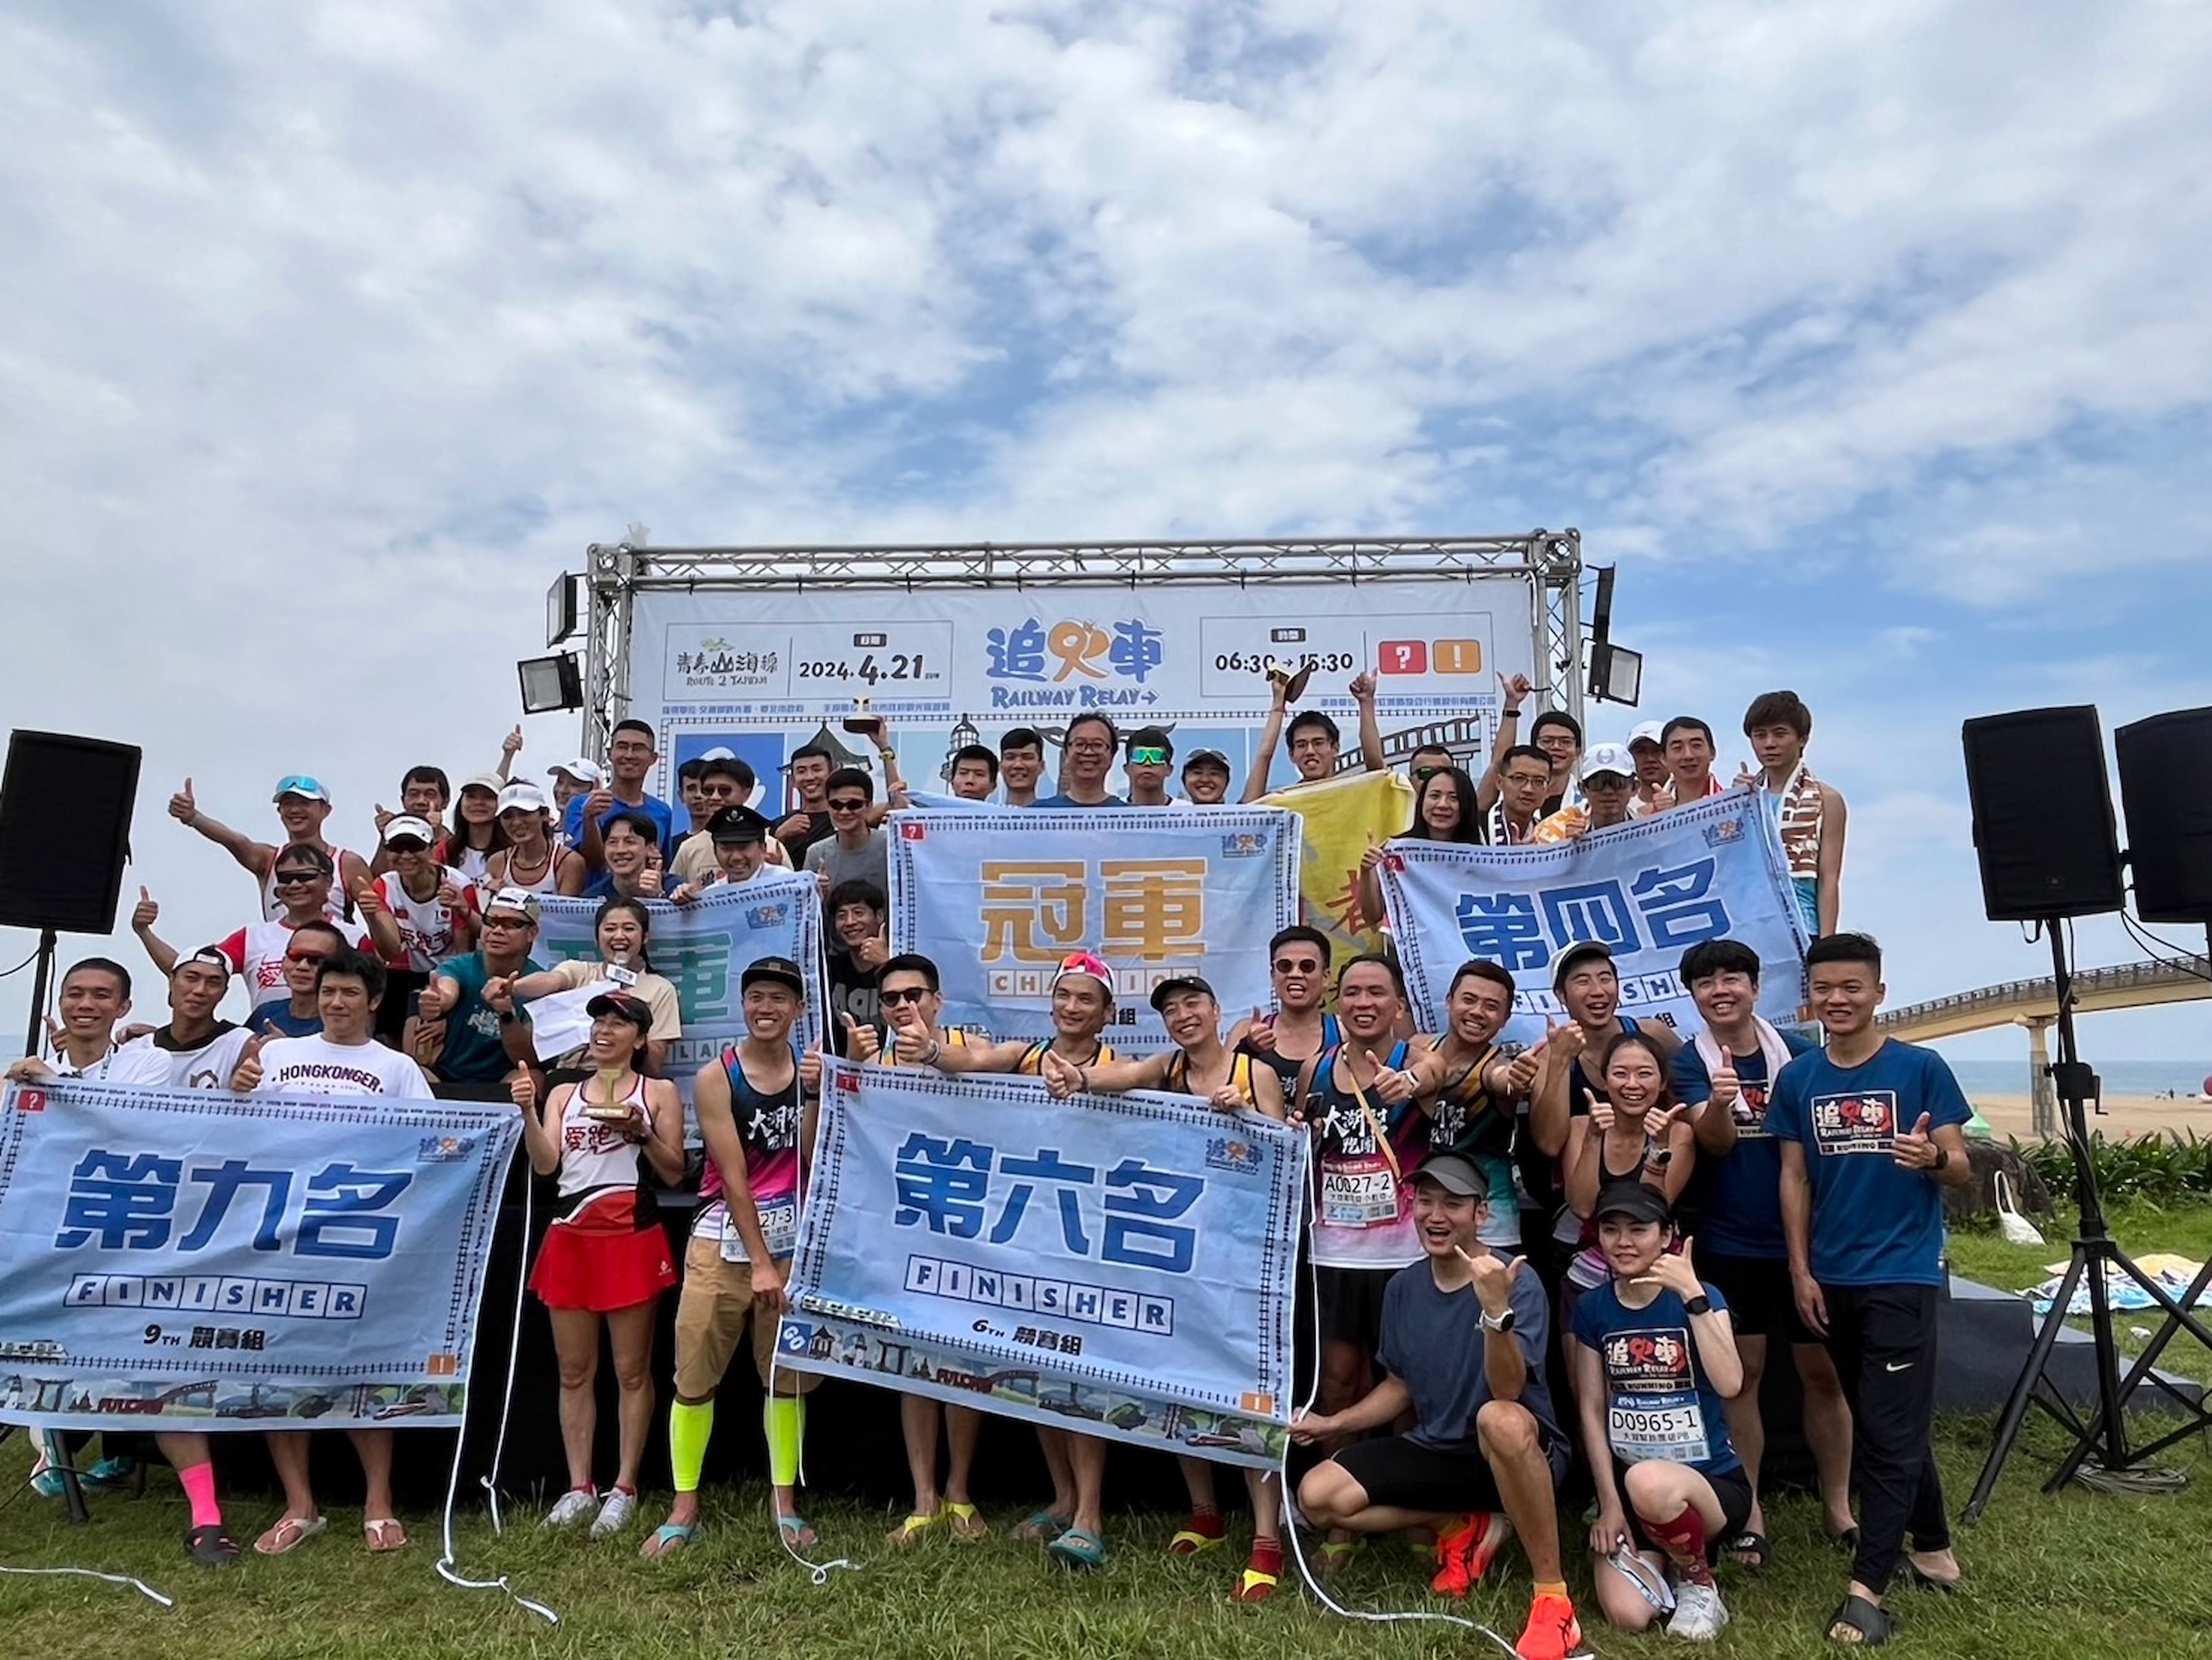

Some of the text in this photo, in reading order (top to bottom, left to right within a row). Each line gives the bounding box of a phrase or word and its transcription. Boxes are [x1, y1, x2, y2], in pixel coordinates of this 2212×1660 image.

[1395, 646, 1411, 669] ?
[991, 684, 1140, 708] RAILWAY RELAY
[981, 859, 1206, 961] 冠軍
[1456, 857, 1731, 972] 第四名
[280, 1064, 380, 1093] HONGKONGER
[1325, 1173, 1390, 1194] A0027-2
[55, 1149, 412, 1259] 第九名
[895, 1132, 1205, 1273] 第六名
[726, 1208, 792, 1229] A27-3
[78, 1281, 355, 1312] FINISHER
[919, 1265, 1165, 1326] FINISHER
[783, 1324, 807, 1351] GO
[1612, 1409, 1698, 1431] D0965-1
